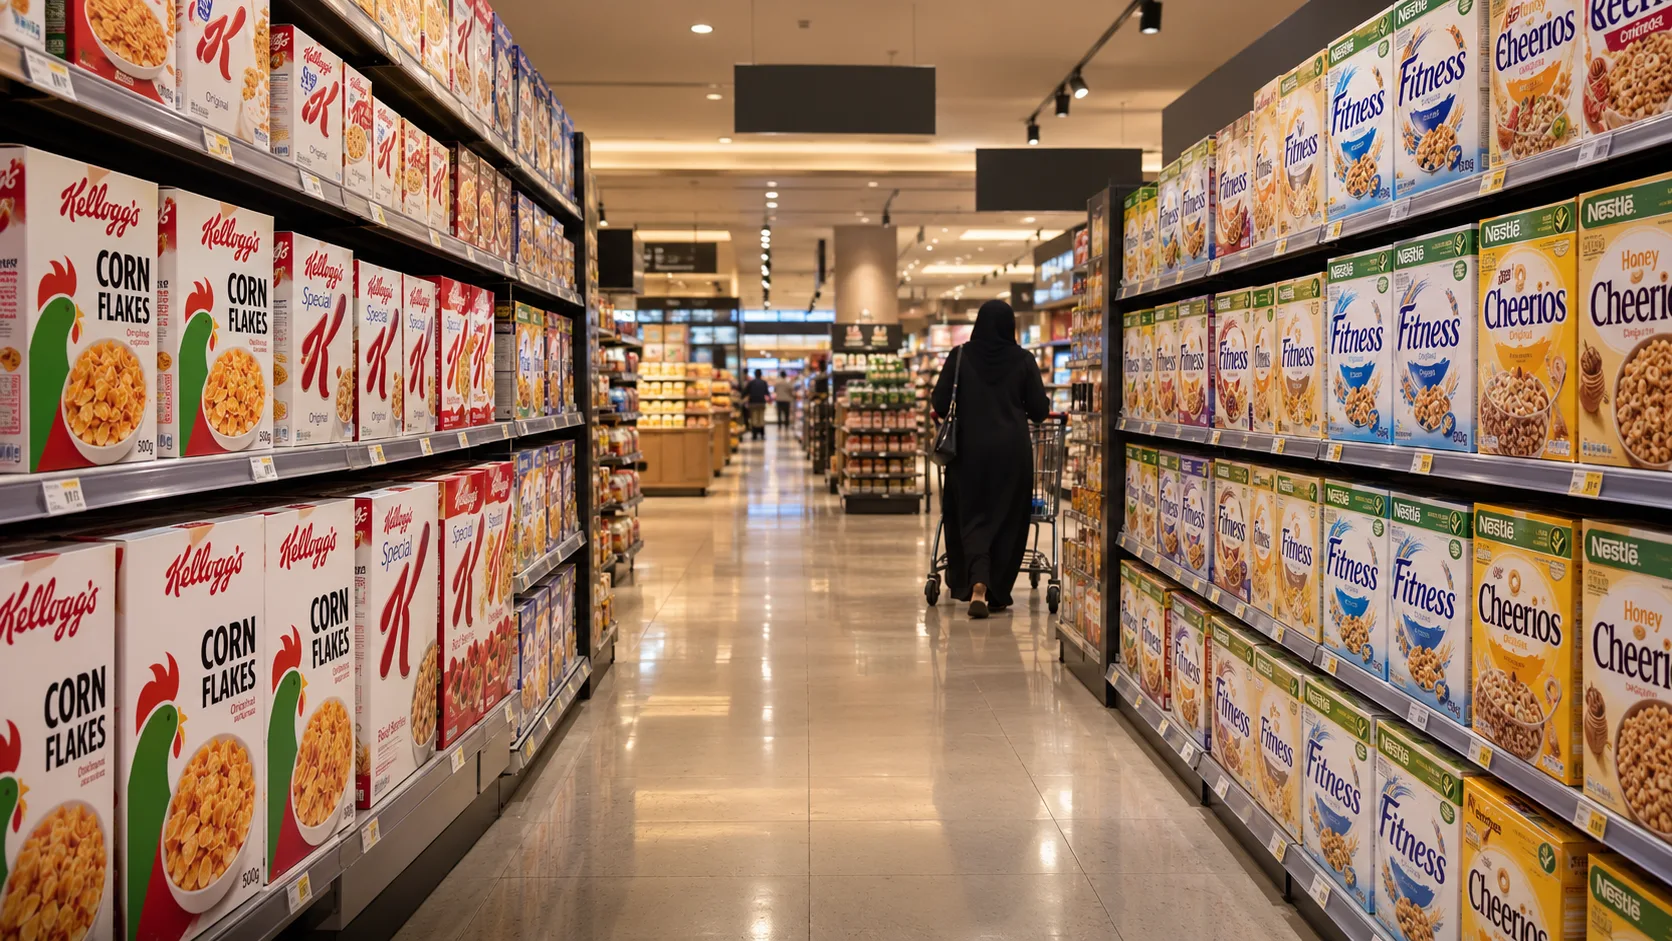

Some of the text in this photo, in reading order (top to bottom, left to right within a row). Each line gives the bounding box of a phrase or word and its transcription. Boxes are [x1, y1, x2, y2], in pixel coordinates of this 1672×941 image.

[1495, 9, 1576, 72] Cheerios
[206, 91, 229, 111] Original
[1398, 51, 1467, 107] Fitness
[1331, 89, 1385, 137] Fitness
[1284, 133, 1319, 168] Fitness
[60, 177, 140, 238] Kellogg's
[1218, 170, 1248, 202] Fitness
[201, 213, 261, 262] Kellogg's
[1621, 250, 1660, 271] Honey
[96, 249, 150, 293] CORN
[227, 272, 268, 308] CORN
[304, 250, 344, 289] Kellogg's
[97, 291, 150, 325] FLAKES
[228, 307, 268, 335] FLAKES
[302, 286, 332, 311] Special
[1484, 288, 1567, 329] Cheerios
[1590, 280, 1672, 328] Cheeri
[1331, 313, 1384, 355] Fitness
[1397, 303, 1461, 352] Fitness
[1219, 340, 1249, 370] Fitness
[1281, 338, 1315, 368] Fitness
[138, 440, 154, 456] 500g
[279, 523, 337, 570] Kellogg's
[1218, 504, 1246, 542] Fitness
[165, 541, 244, 598] Kellogg's
[381, 534, 413, 572] Special
[1281, 528, 1313, 566] Fitness
[1326, 537, 1379, 591] Fitness
[0, 577, 100, 646] Kellogg's
[310, 587, 349, 634] CORN
[1393, 558, 1456, 620] Fitness
[1478, 582, 1562, 647] Cheerios
[1624, 599, 1663, 633] Honey
[201, 616, 256, 670] CORN
[312, 626, 350, 669] FLAKES
[1592, 621, 1672, 690] Cheeri
[44, 665, 106, 728] CORN
[202, 659, 256, 708] FLAKES
[1215, 676, 1251, 738] Fitness
[45, 715, 106, 772] FLAKES
[1260, 715, 1294, 768] Fitness
[1306, 738, 1361, 815] Fitness
[1379, 793, 1447, 885] Fitness
